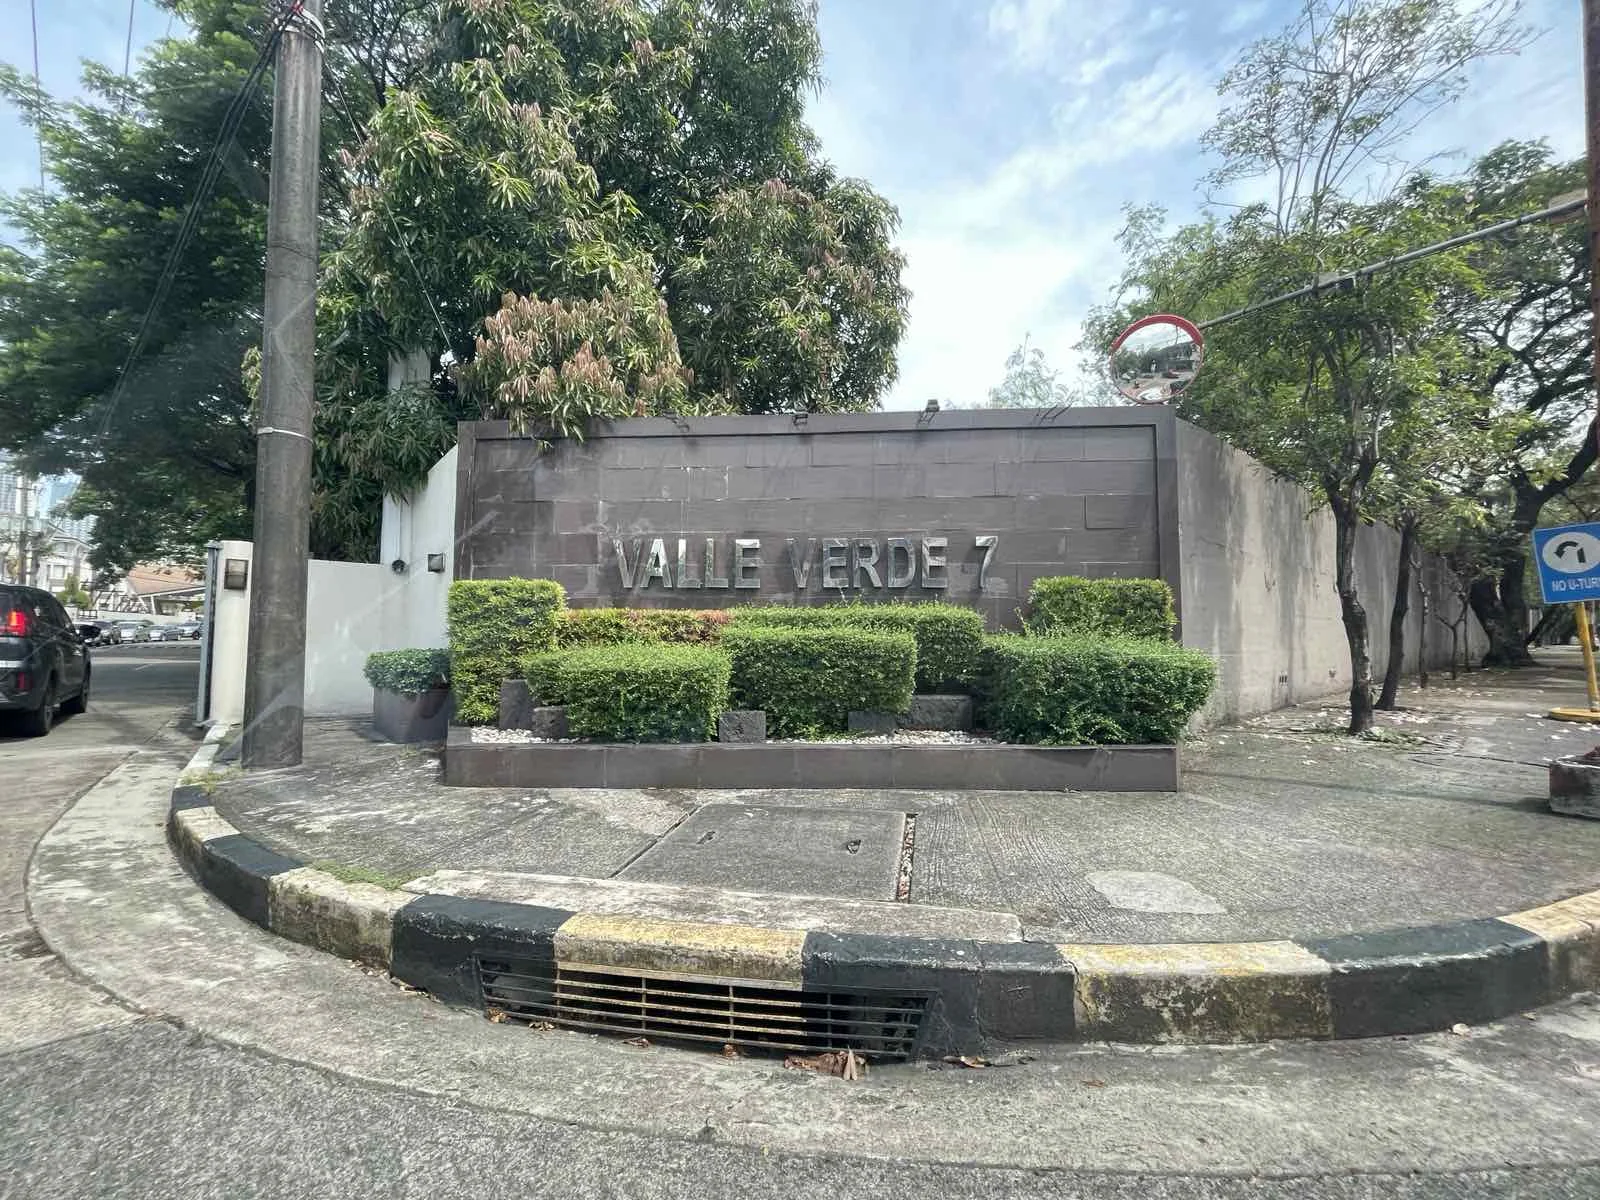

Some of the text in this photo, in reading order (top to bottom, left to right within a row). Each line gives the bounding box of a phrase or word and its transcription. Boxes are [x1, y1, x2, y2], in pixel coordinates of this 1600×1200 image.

[613, 535, 999, 588] VALLE VERDE 7
[1552, 577, 1600, 592] NO U-TUR
